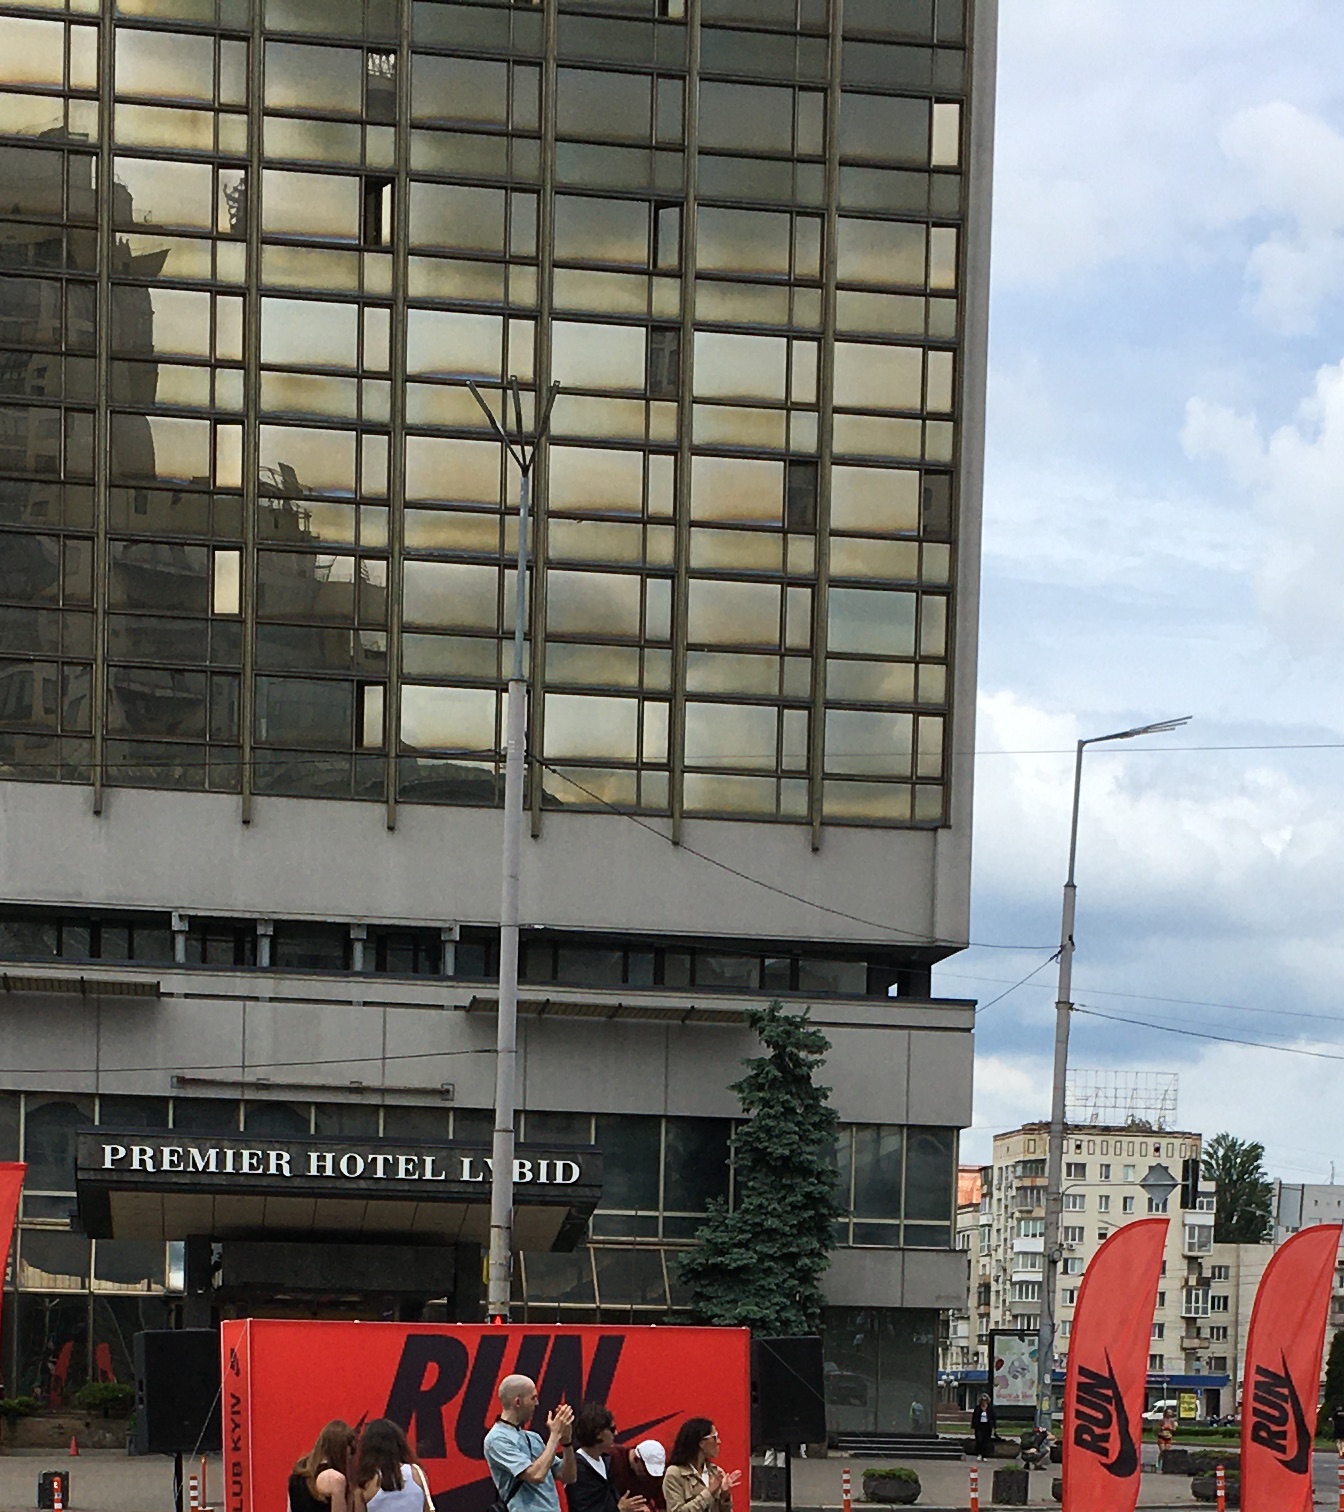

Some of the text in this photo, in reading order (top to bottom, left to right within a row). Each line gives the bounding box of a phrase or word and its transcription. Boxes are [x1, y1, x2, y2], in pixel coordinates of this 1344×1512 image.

[101, 1144, 293, 1178] PREMIER
[306, 1151, 447, 1182] HOTEL
[230, 1392, 243, 1452] KYIV
[1074, 1364, 1116, 1458] RUN
[1250, 1364, 1292, 1454] RUN
